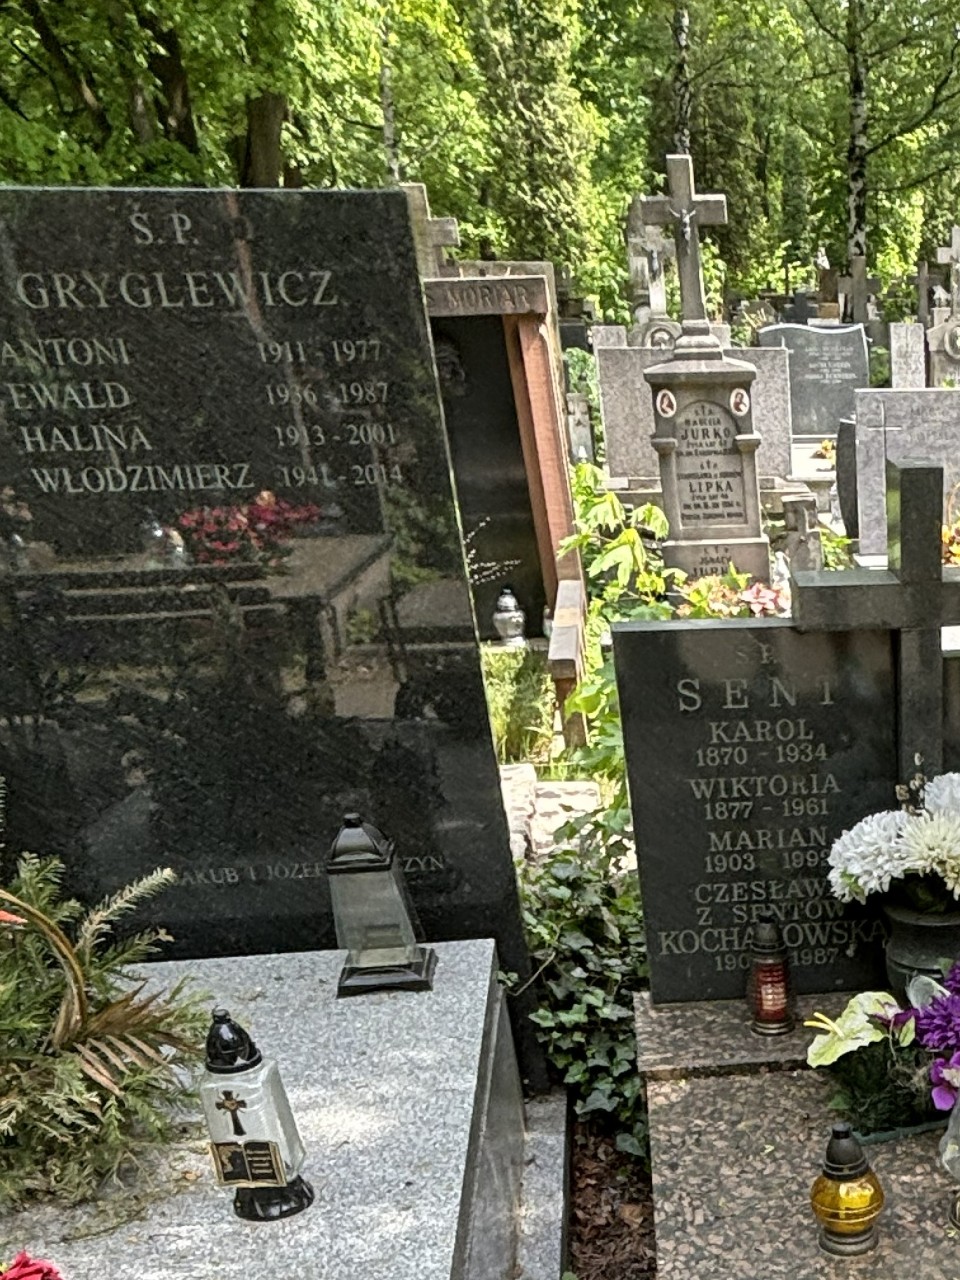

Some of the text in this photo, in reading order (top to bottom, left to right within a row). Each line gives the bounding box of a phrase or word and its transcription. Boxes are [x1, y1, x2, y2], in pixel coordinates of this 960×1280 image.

[16, 269, 339, 309] GRYGLEWICZ
[0, 337, 131, 367] ANTONI
[257, 340, 307, 363] 1911
[331, 339, 382, 362] 1977
[6, 381, 132, 411] EWALD
[340, 381, 389, 404] 1987
[20, 425, 153, 454] HALINA
[346, 423, 396, 445] 2001
[681, 427, 731, 440] JURKO
[351, 462, 403, 485] 2014
[709, 717, 815, 745] KAROL
[695, 746, 748, 768] 1870
[776, 742, 829, 765] 1934
[687, 772, 842, 801] WIKTORIA
[703, 800, 754, 821] 1877
[782, 796, 831, 818] 1961
[708, 824, 829, 852] MARIAN
[177, 866, 239, 885] AKUB
[703, 853, 756, 874] 1903
[694, 876, 832, 905] CZESŁAW
[696, 905, 714, 926] Z
[657, 918, 889, 957] KOCHAOWSKA
[715, 946, 841, 973] 190 1987
